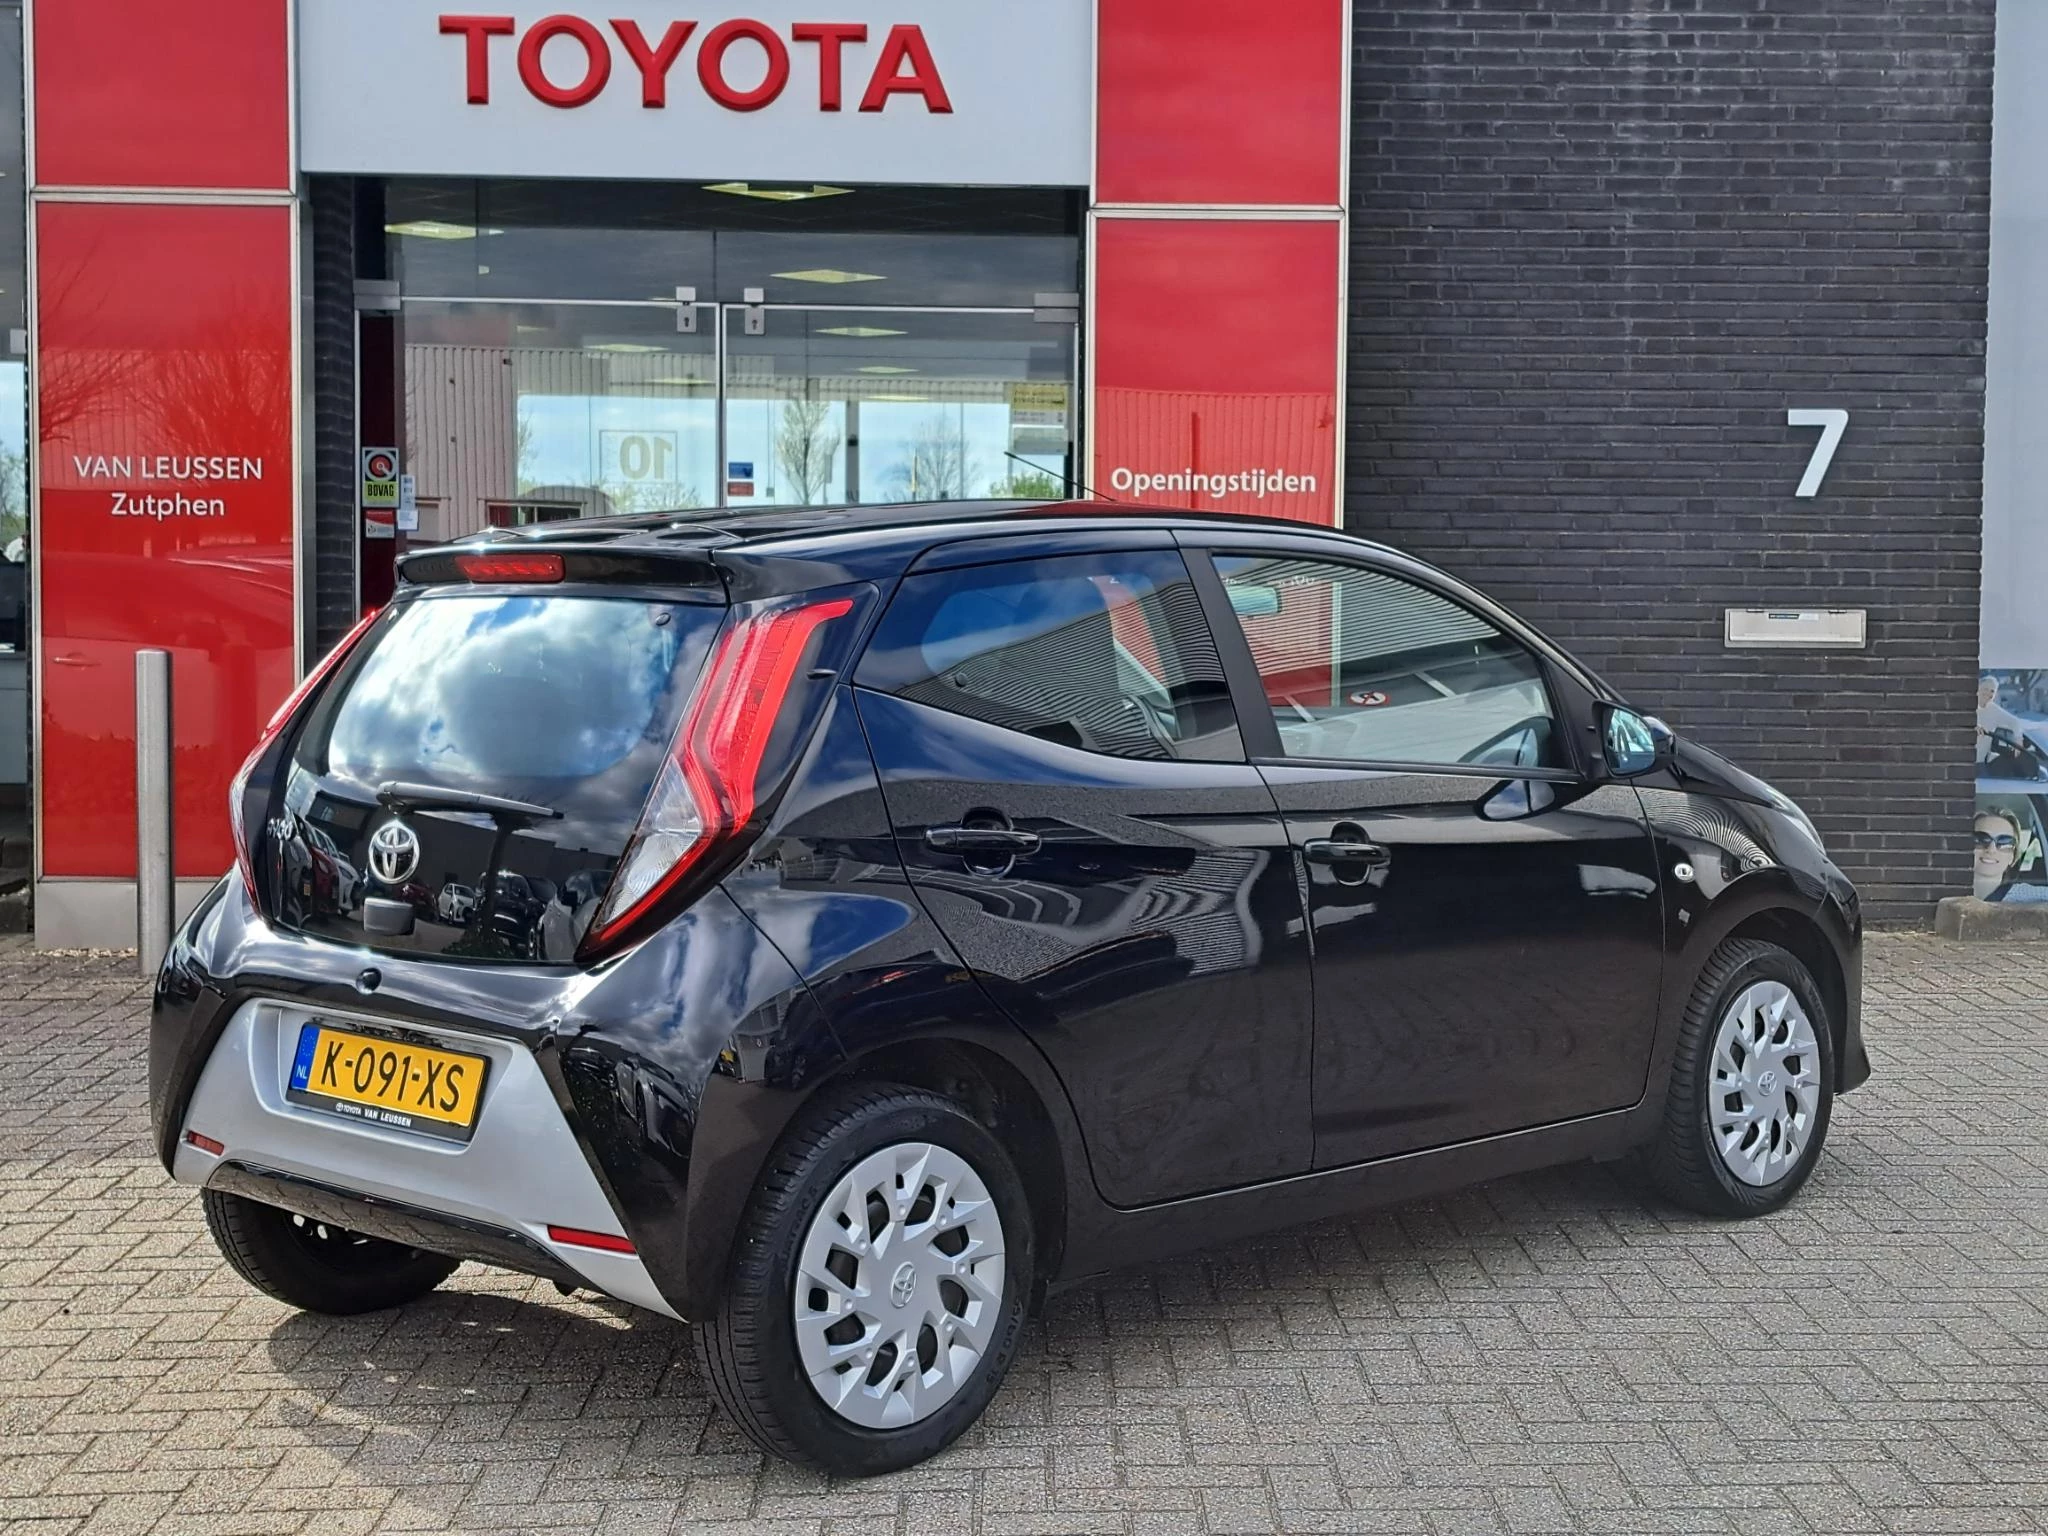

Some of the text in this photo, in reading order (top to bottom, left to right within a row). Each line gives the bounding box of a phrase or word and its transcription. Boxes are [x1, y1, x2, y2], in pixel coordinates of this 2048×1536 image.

[438, 14, 955, 114] TOYOTA
[1787, 408, 1849, 497] 7
[73, 455, 263, 480] VAN LEUSSEN
[367, 484, 395, 497] BOVAG
[1111, 467, 1316, 498] Openingstijden
[111, 492, 225, 521] Zutphen
[296, 1064, 308, 1079] NL
[320, 1040, 465, 1113] K-091-XS
[343, 1104, 412, 1127] TOYOTA VAN LEUSSEN
